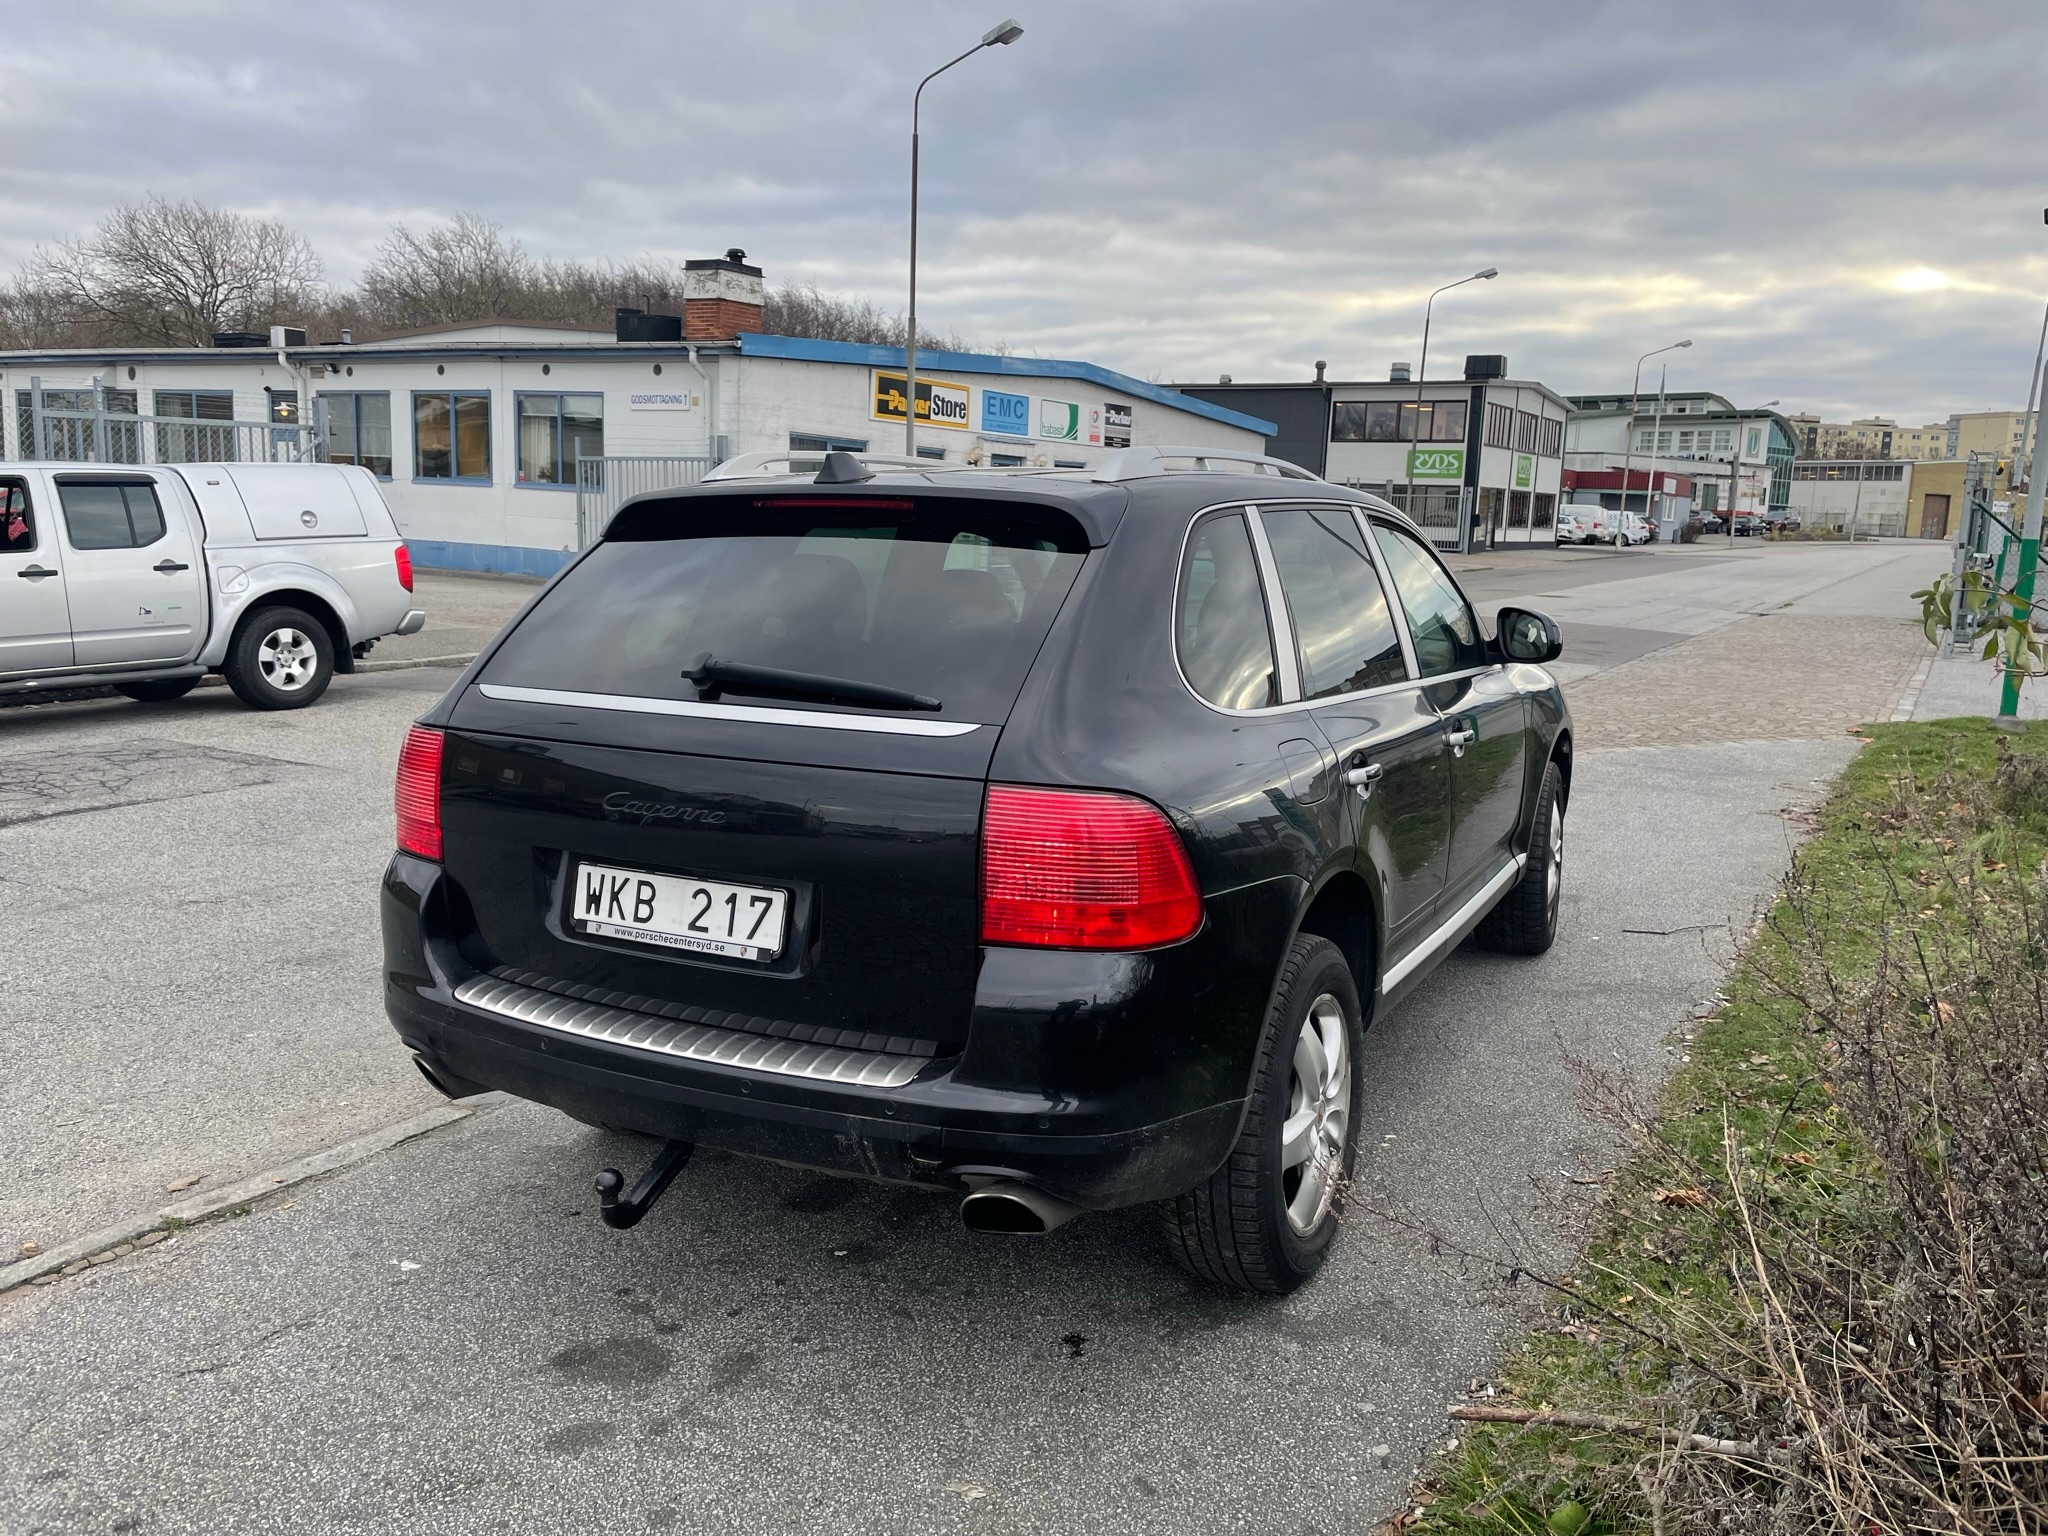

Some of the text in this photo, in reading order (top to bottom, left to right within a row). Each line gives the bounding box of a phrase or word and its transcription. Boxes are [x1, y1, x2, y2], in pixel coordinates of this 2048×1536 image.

[631, 394, 682, 405] GODSMOTTAGNING
[932, 394, 966, 420] Store
[987, 395, 1024, 420] EMC
[1109, 409, 1132, 425] Parker
[1041, 424, 1065, 436] habasit
[601, 791, 726, 827] Cayenne
[585, 872, 773, 940] WKB 217
[614, 927, 725, 953] www.porschecentersyd.se
